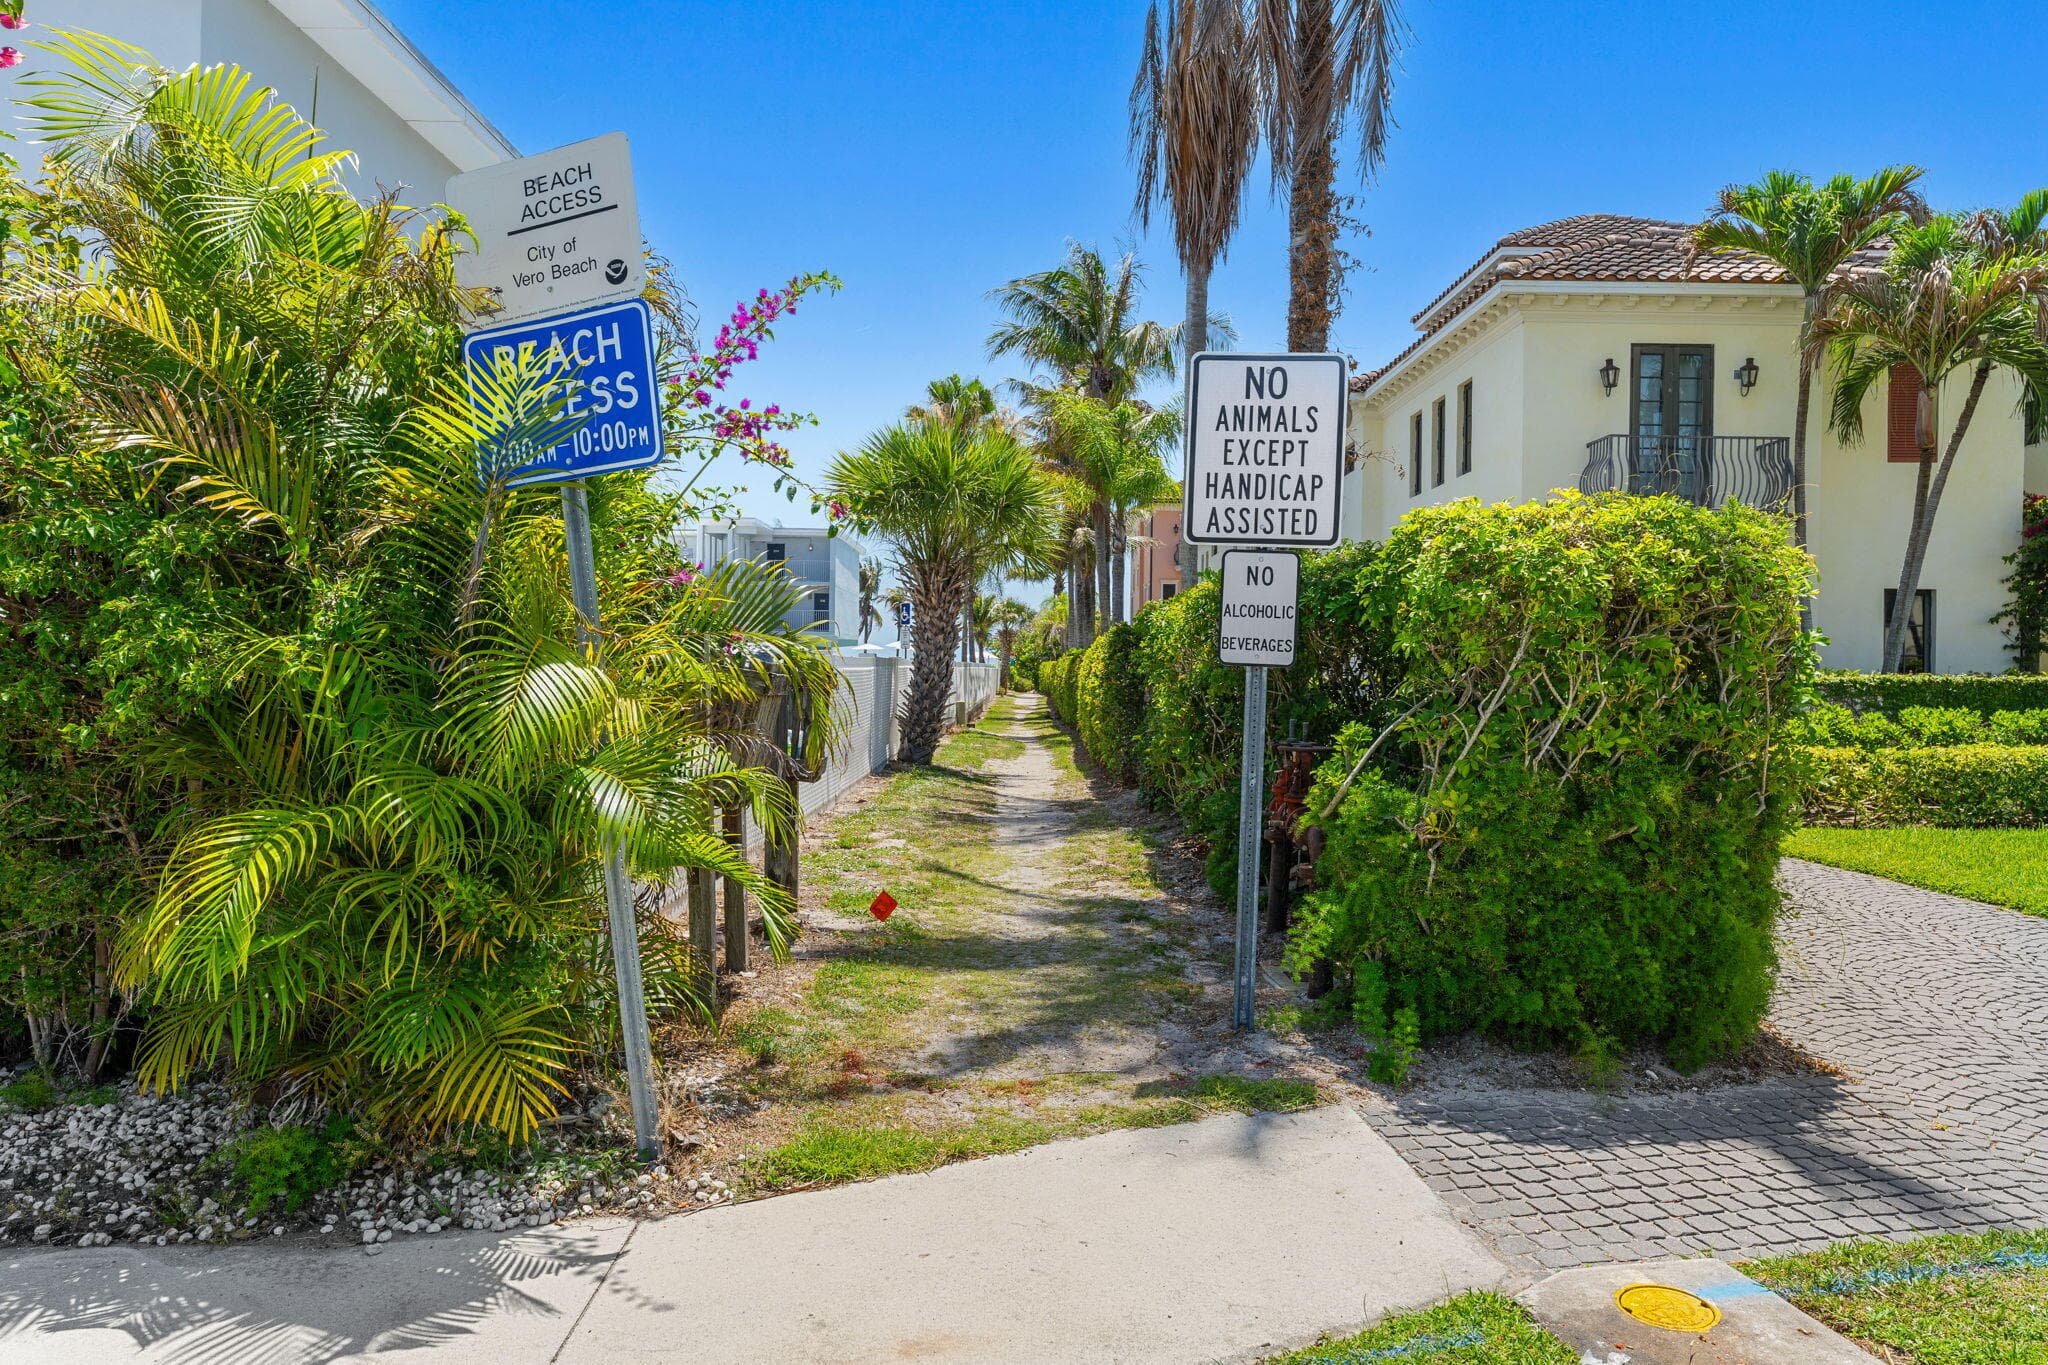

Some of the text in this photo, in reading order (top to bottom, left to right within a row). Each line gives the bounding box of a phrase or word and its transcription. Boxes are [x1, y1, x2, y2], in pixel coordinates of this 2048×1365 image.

[524, 163, 592, 197] BEACH
[521, 186, 602, 222] ACCESS
[527, 236, 576, 262] City of
[512, 256, 597, 288] Vero Beach
[494, 322, 622, 384] BEACH
[1245, 366, 1288, 400] NO
[1215, 405, 1319, 433] ANIMALS
[1223, 439, 1309, 467] EXCEPT
[1205, 472, 1323, 501] HANDICAP
[1206, 507, 1318, 535] ASSISTED
[1246, 565, 1274, 586] NO
[1223, 604, 1294, 619] ALCOHOLIC
[1221, 637, 1293, 653] BEVERAGES
